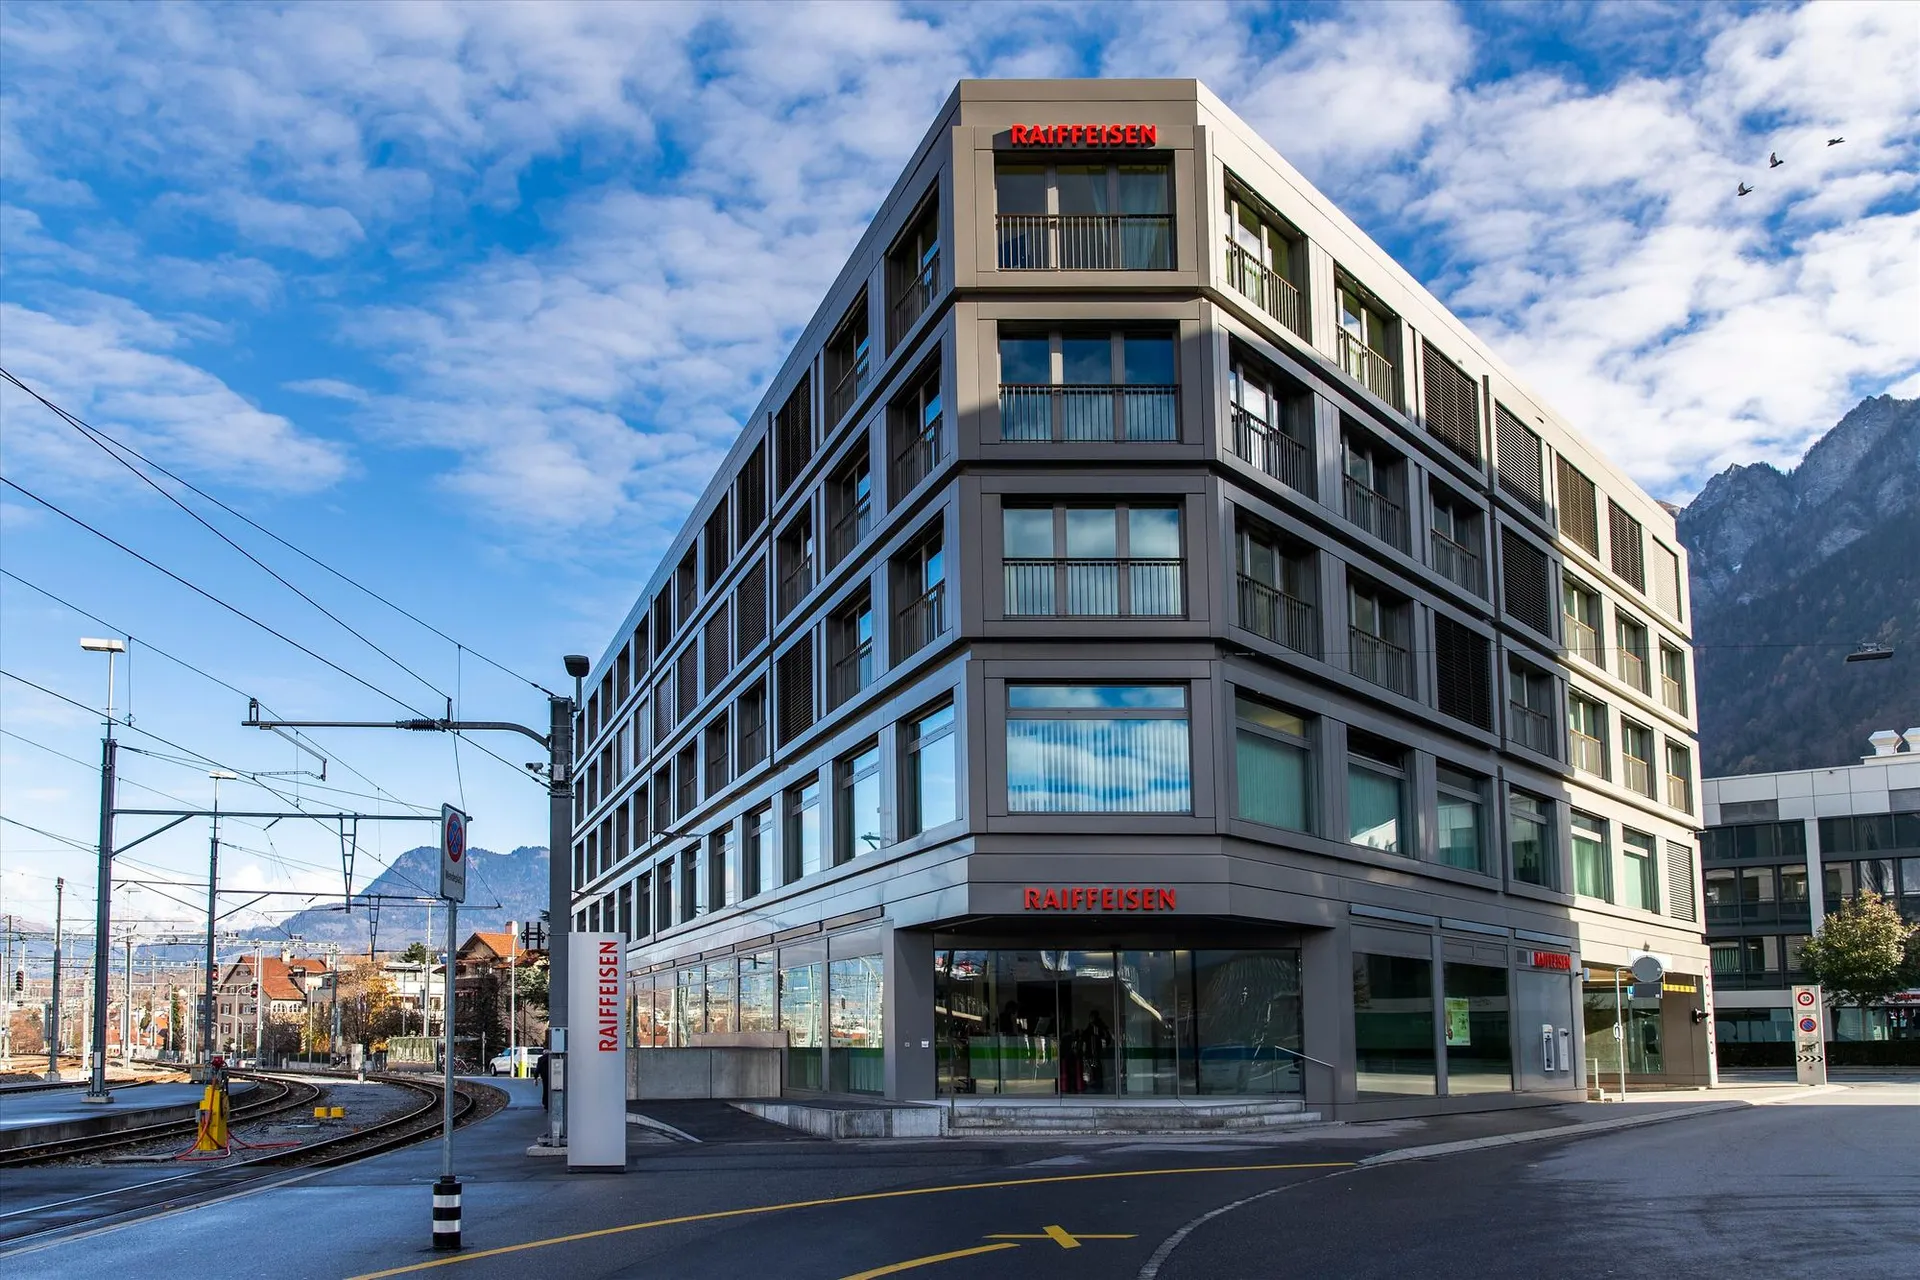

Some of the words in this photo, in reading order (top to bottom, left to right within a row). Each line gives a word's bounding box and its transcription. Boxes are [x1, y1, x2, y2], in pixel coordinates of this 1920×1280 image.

[1011, 124, 1157, 146] RAIFFEISEN
[1024, 888, 1176, 910] RAIFFEISEN
[599, 942, 618, 1052] RAIFFEISEN
